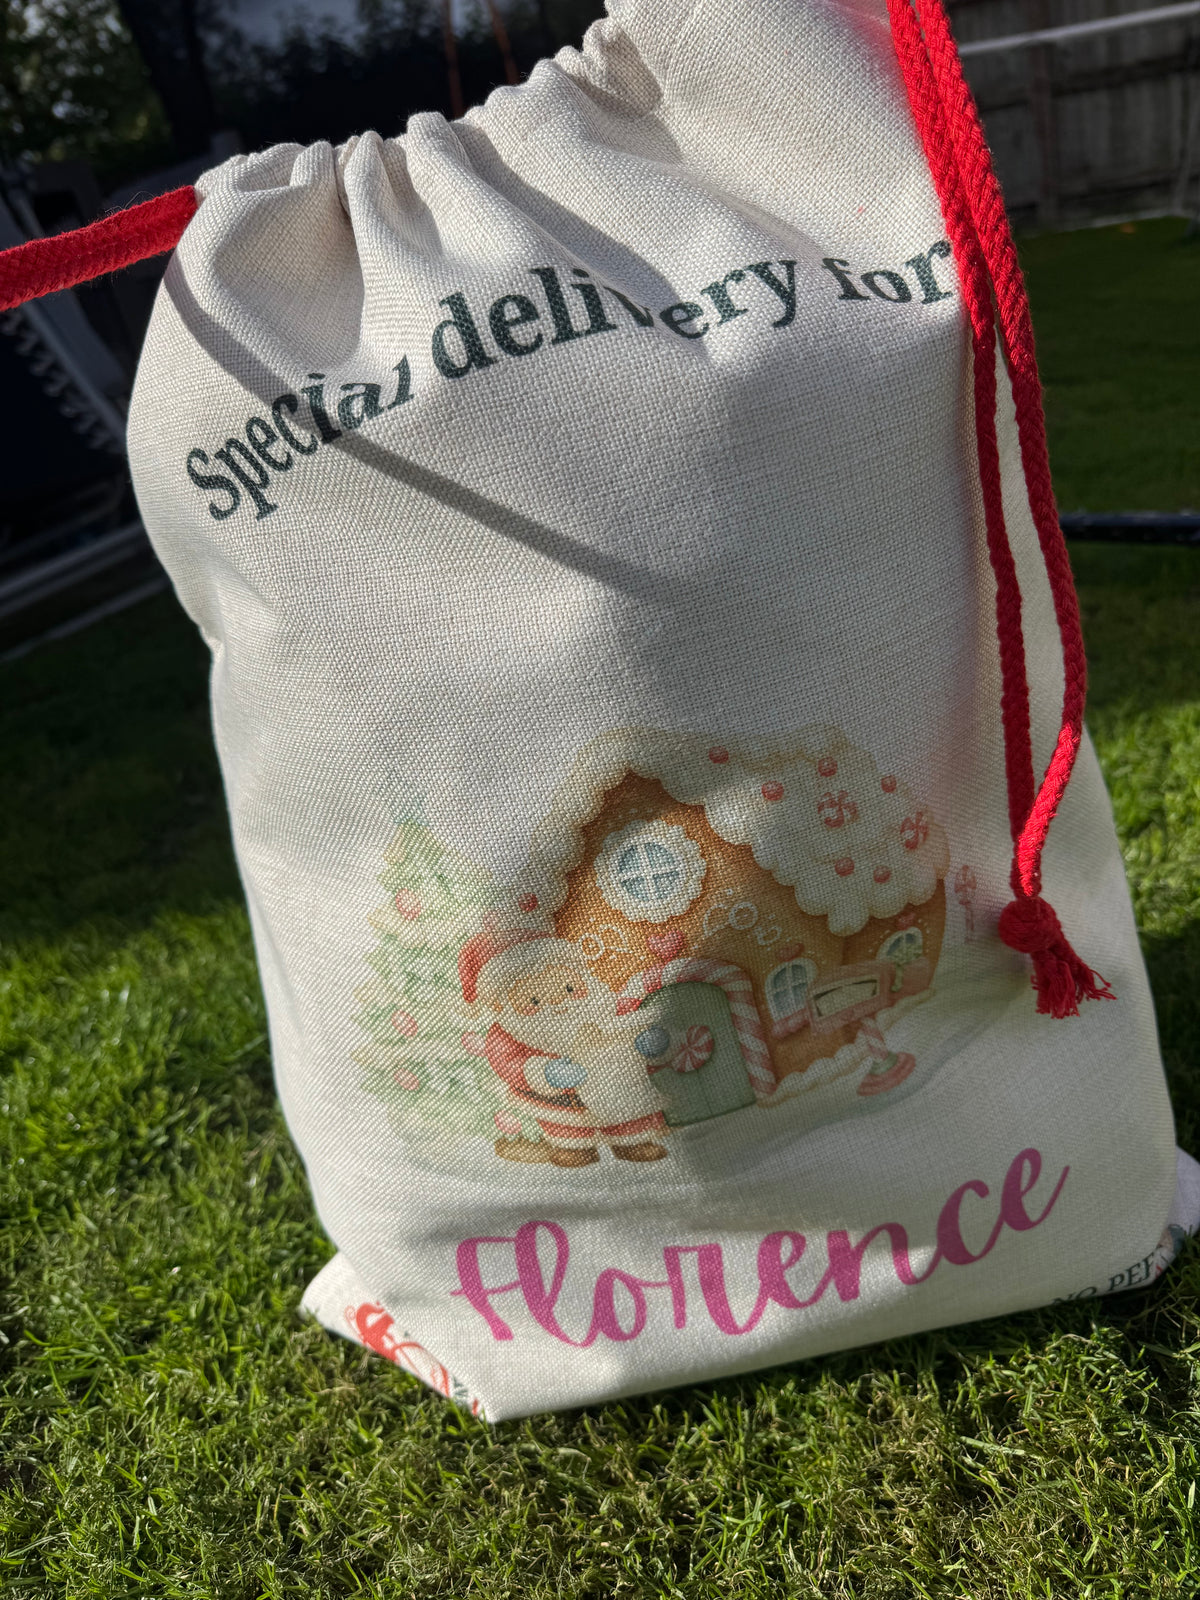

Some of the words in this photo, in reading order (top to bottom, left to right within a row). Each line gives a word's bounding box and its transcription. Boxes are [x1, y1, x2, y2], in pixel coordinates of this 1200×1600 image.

[186, 354, 415, 522] Special
[431, 266, 797, 379] delivery
[822, 239, 953, 305] for
[450, 1147, 1071, 1348] Florence
